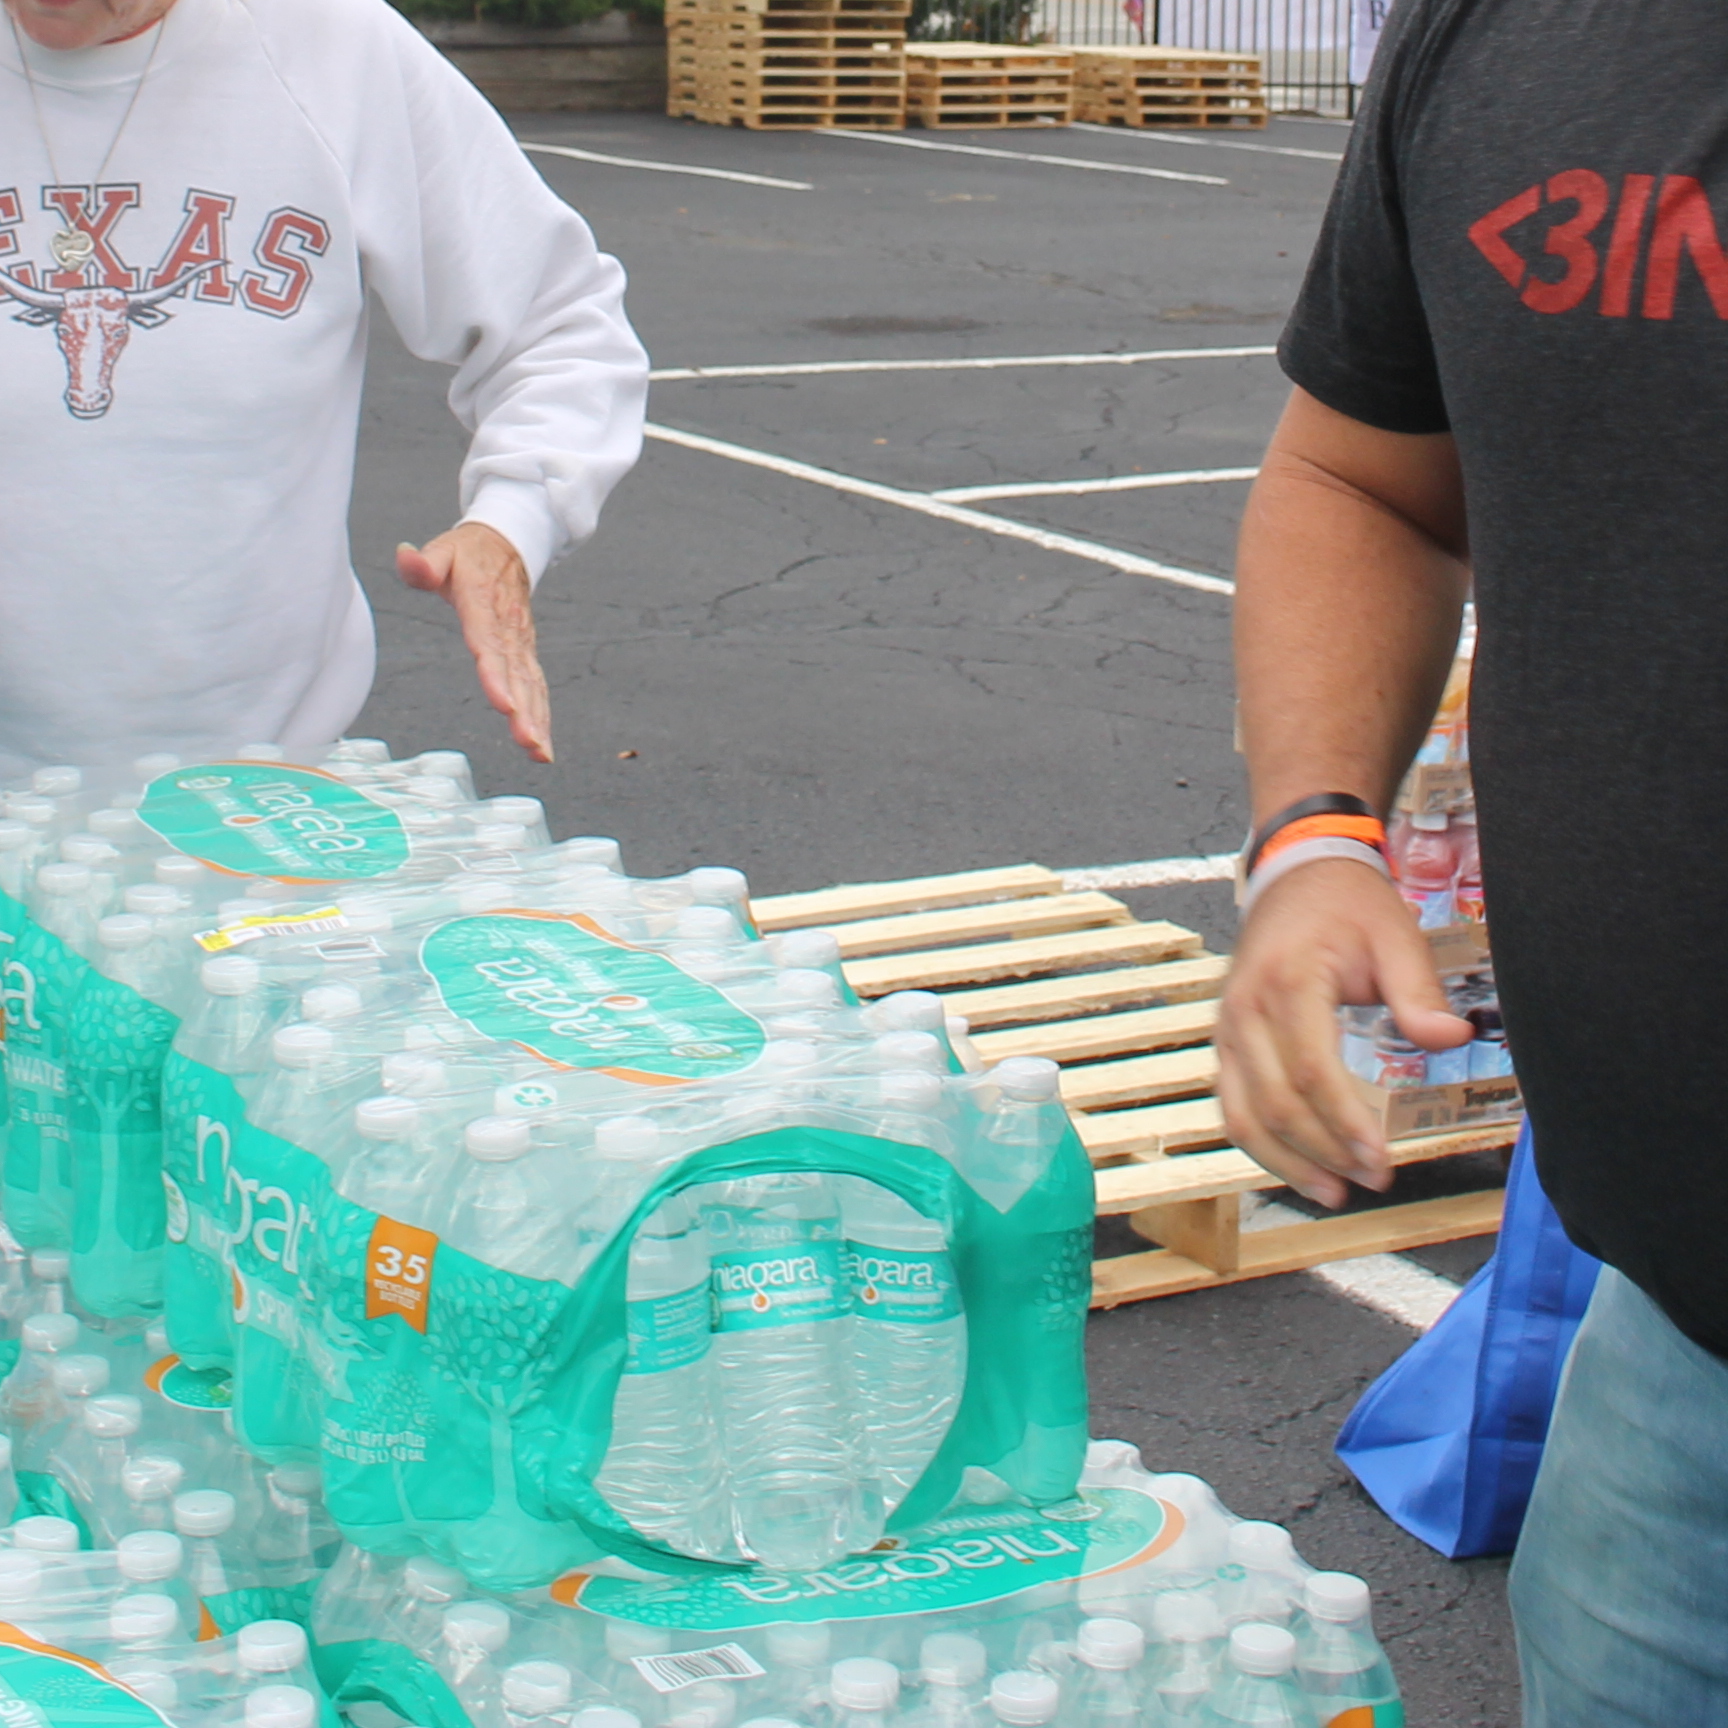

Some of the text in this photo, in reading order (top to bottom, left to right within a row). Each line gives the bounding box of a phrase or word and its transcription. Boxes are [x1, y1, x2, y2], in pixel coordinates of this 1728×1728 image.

[11, 1052, 67, 1092] WATE
[374, 1244, 428, 1286] 35
[722, 1528, 1080, 1603] niagara
